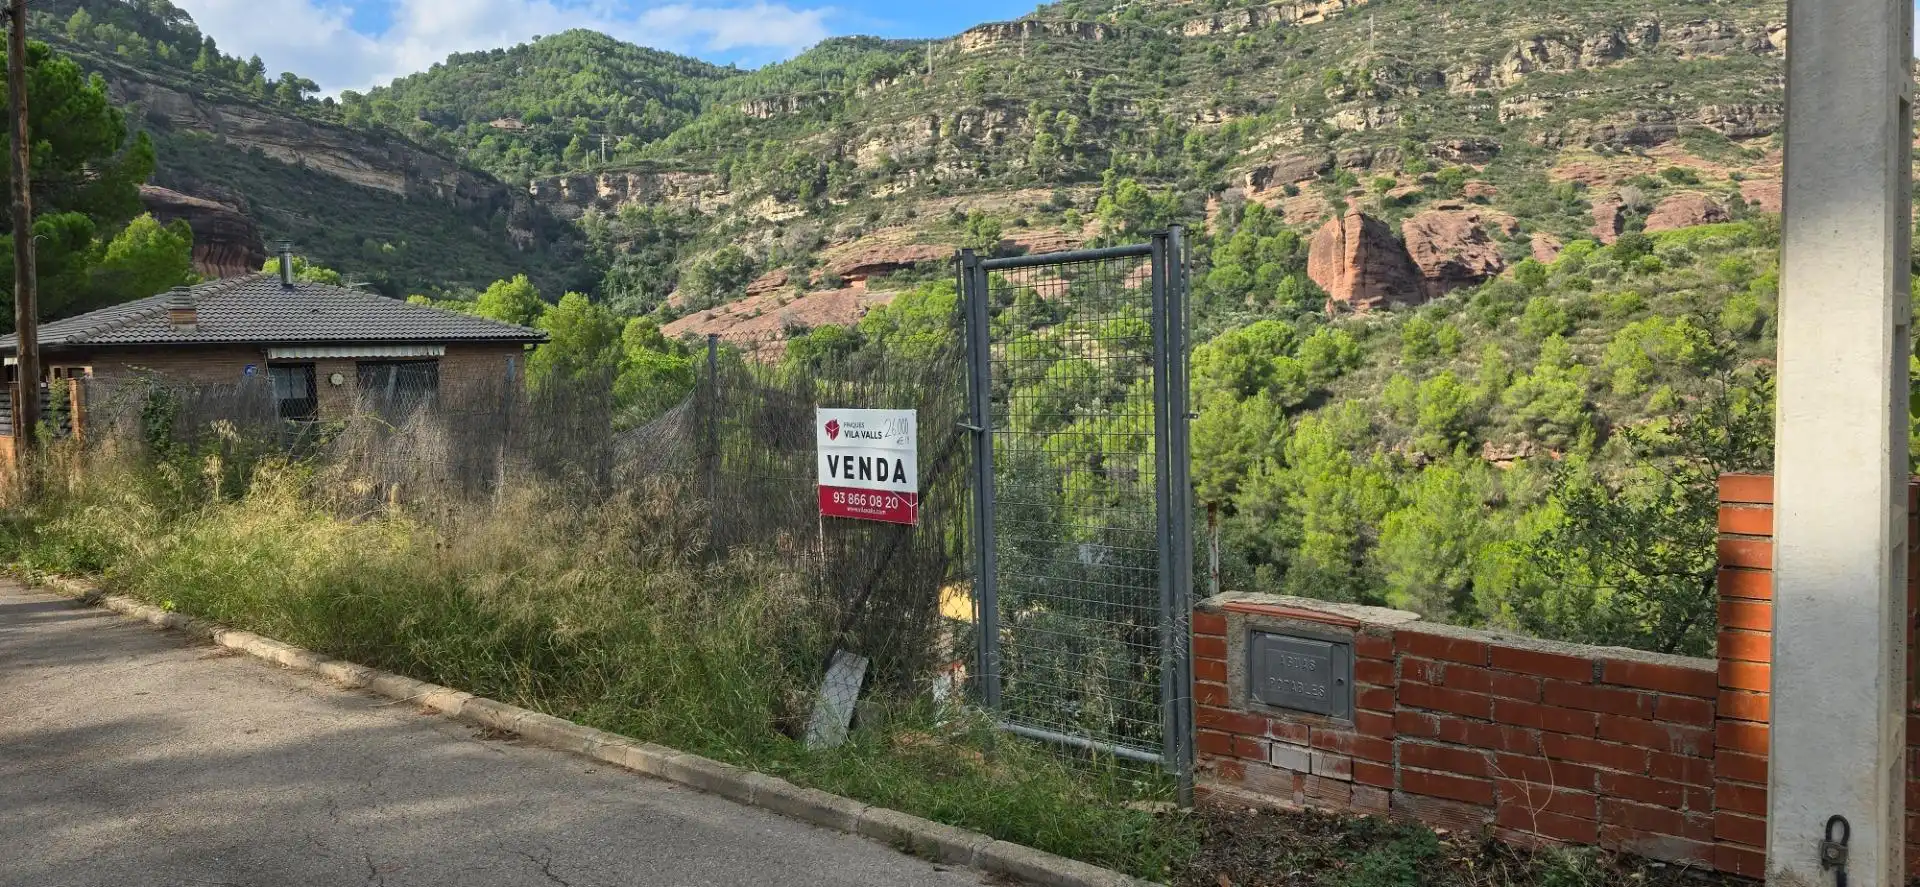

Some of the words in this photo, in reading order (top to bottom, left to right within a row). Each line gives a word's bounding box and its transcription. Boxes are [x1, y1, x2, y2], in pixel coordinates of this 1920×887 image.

[843, 421, 865, 429] FINQUES
[844, 430, 860, 439] VILA
[860, 431, 883, 440] VALLS
[827, 455, 906, 483] VENDA
[833, 491, 846, 504] 93
[847, 493, 867, 506] 866
[869, 495, 883, 508] 08
[885, 496, 899, 509] 20
